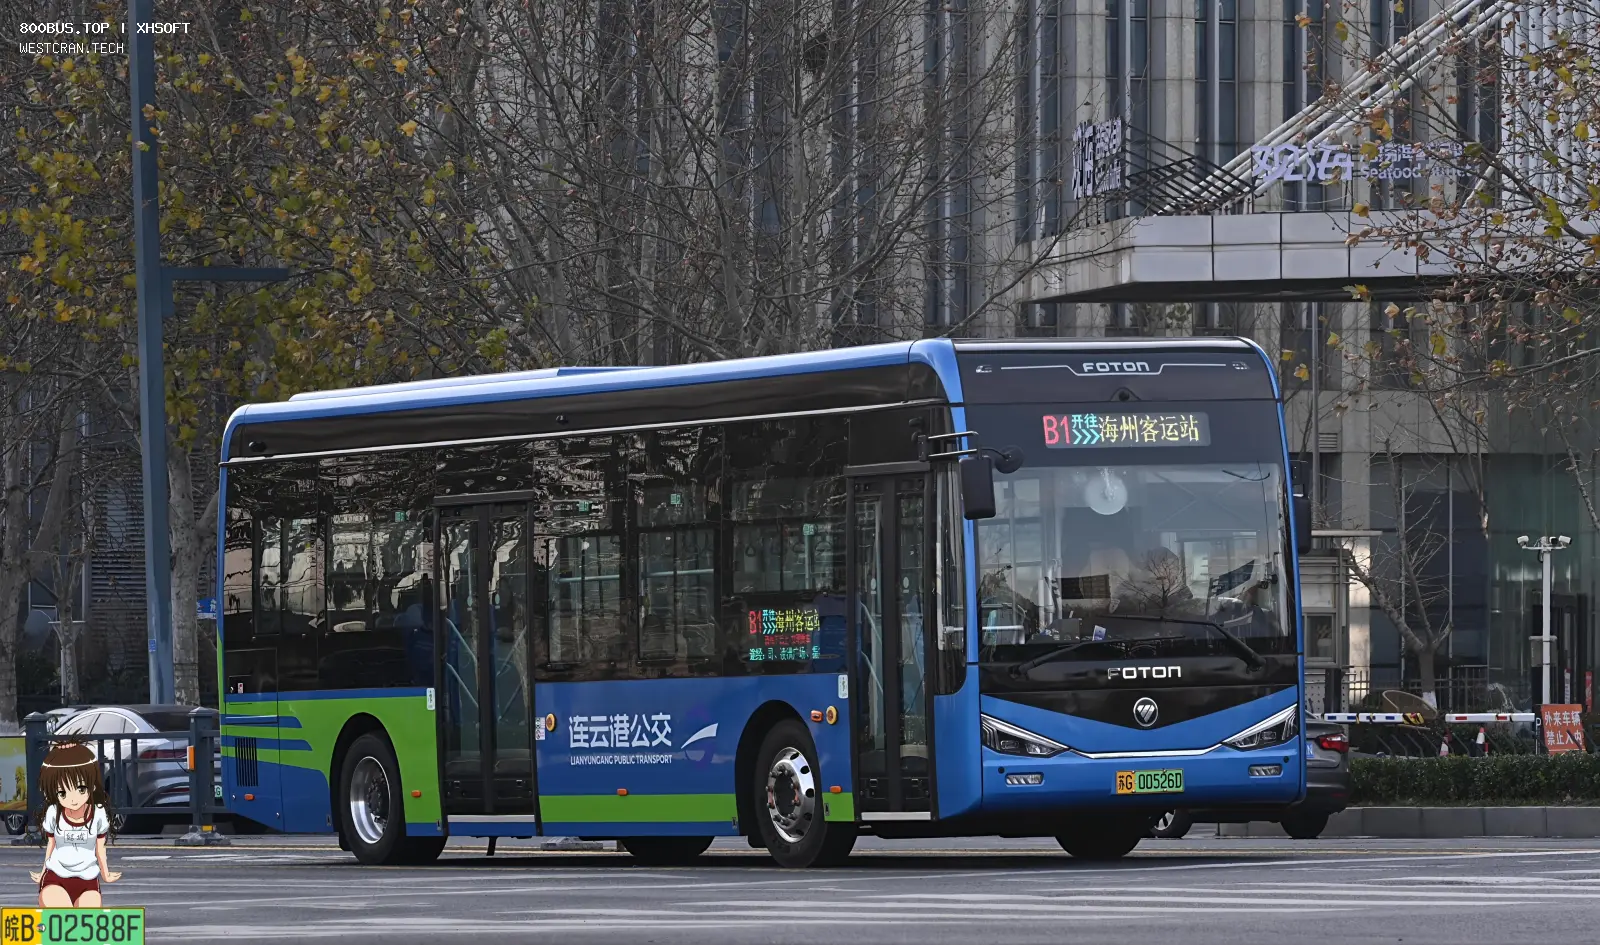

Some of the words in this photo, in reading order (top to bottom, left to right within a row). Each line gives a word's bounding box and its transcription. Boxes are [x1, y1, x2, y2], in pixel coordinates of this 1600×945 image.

[1082, 361, 1150, 373] FOTON
[1042, 415, 1071, 445] B1
[1071, 413, 1099, 429] 开往
[1098, 414, 1200, 443] 海州客运站
[749, 610, 762, 635] B1
[1107, 665, 1182, 680] FOTON
[1544, 710, 1581, 727] 外来车辆
[568, 712, 672, 748] 连云港公交
[1546, 729, 1583, 746] 禁止入内
[570, 755, 613, 766] LIANYUNGANG
[614, 755, 635, 765] PUBLIC
[636, 754, 673, 765] TRANSPORT
[1138, 772, 1182, 790] 00526D
